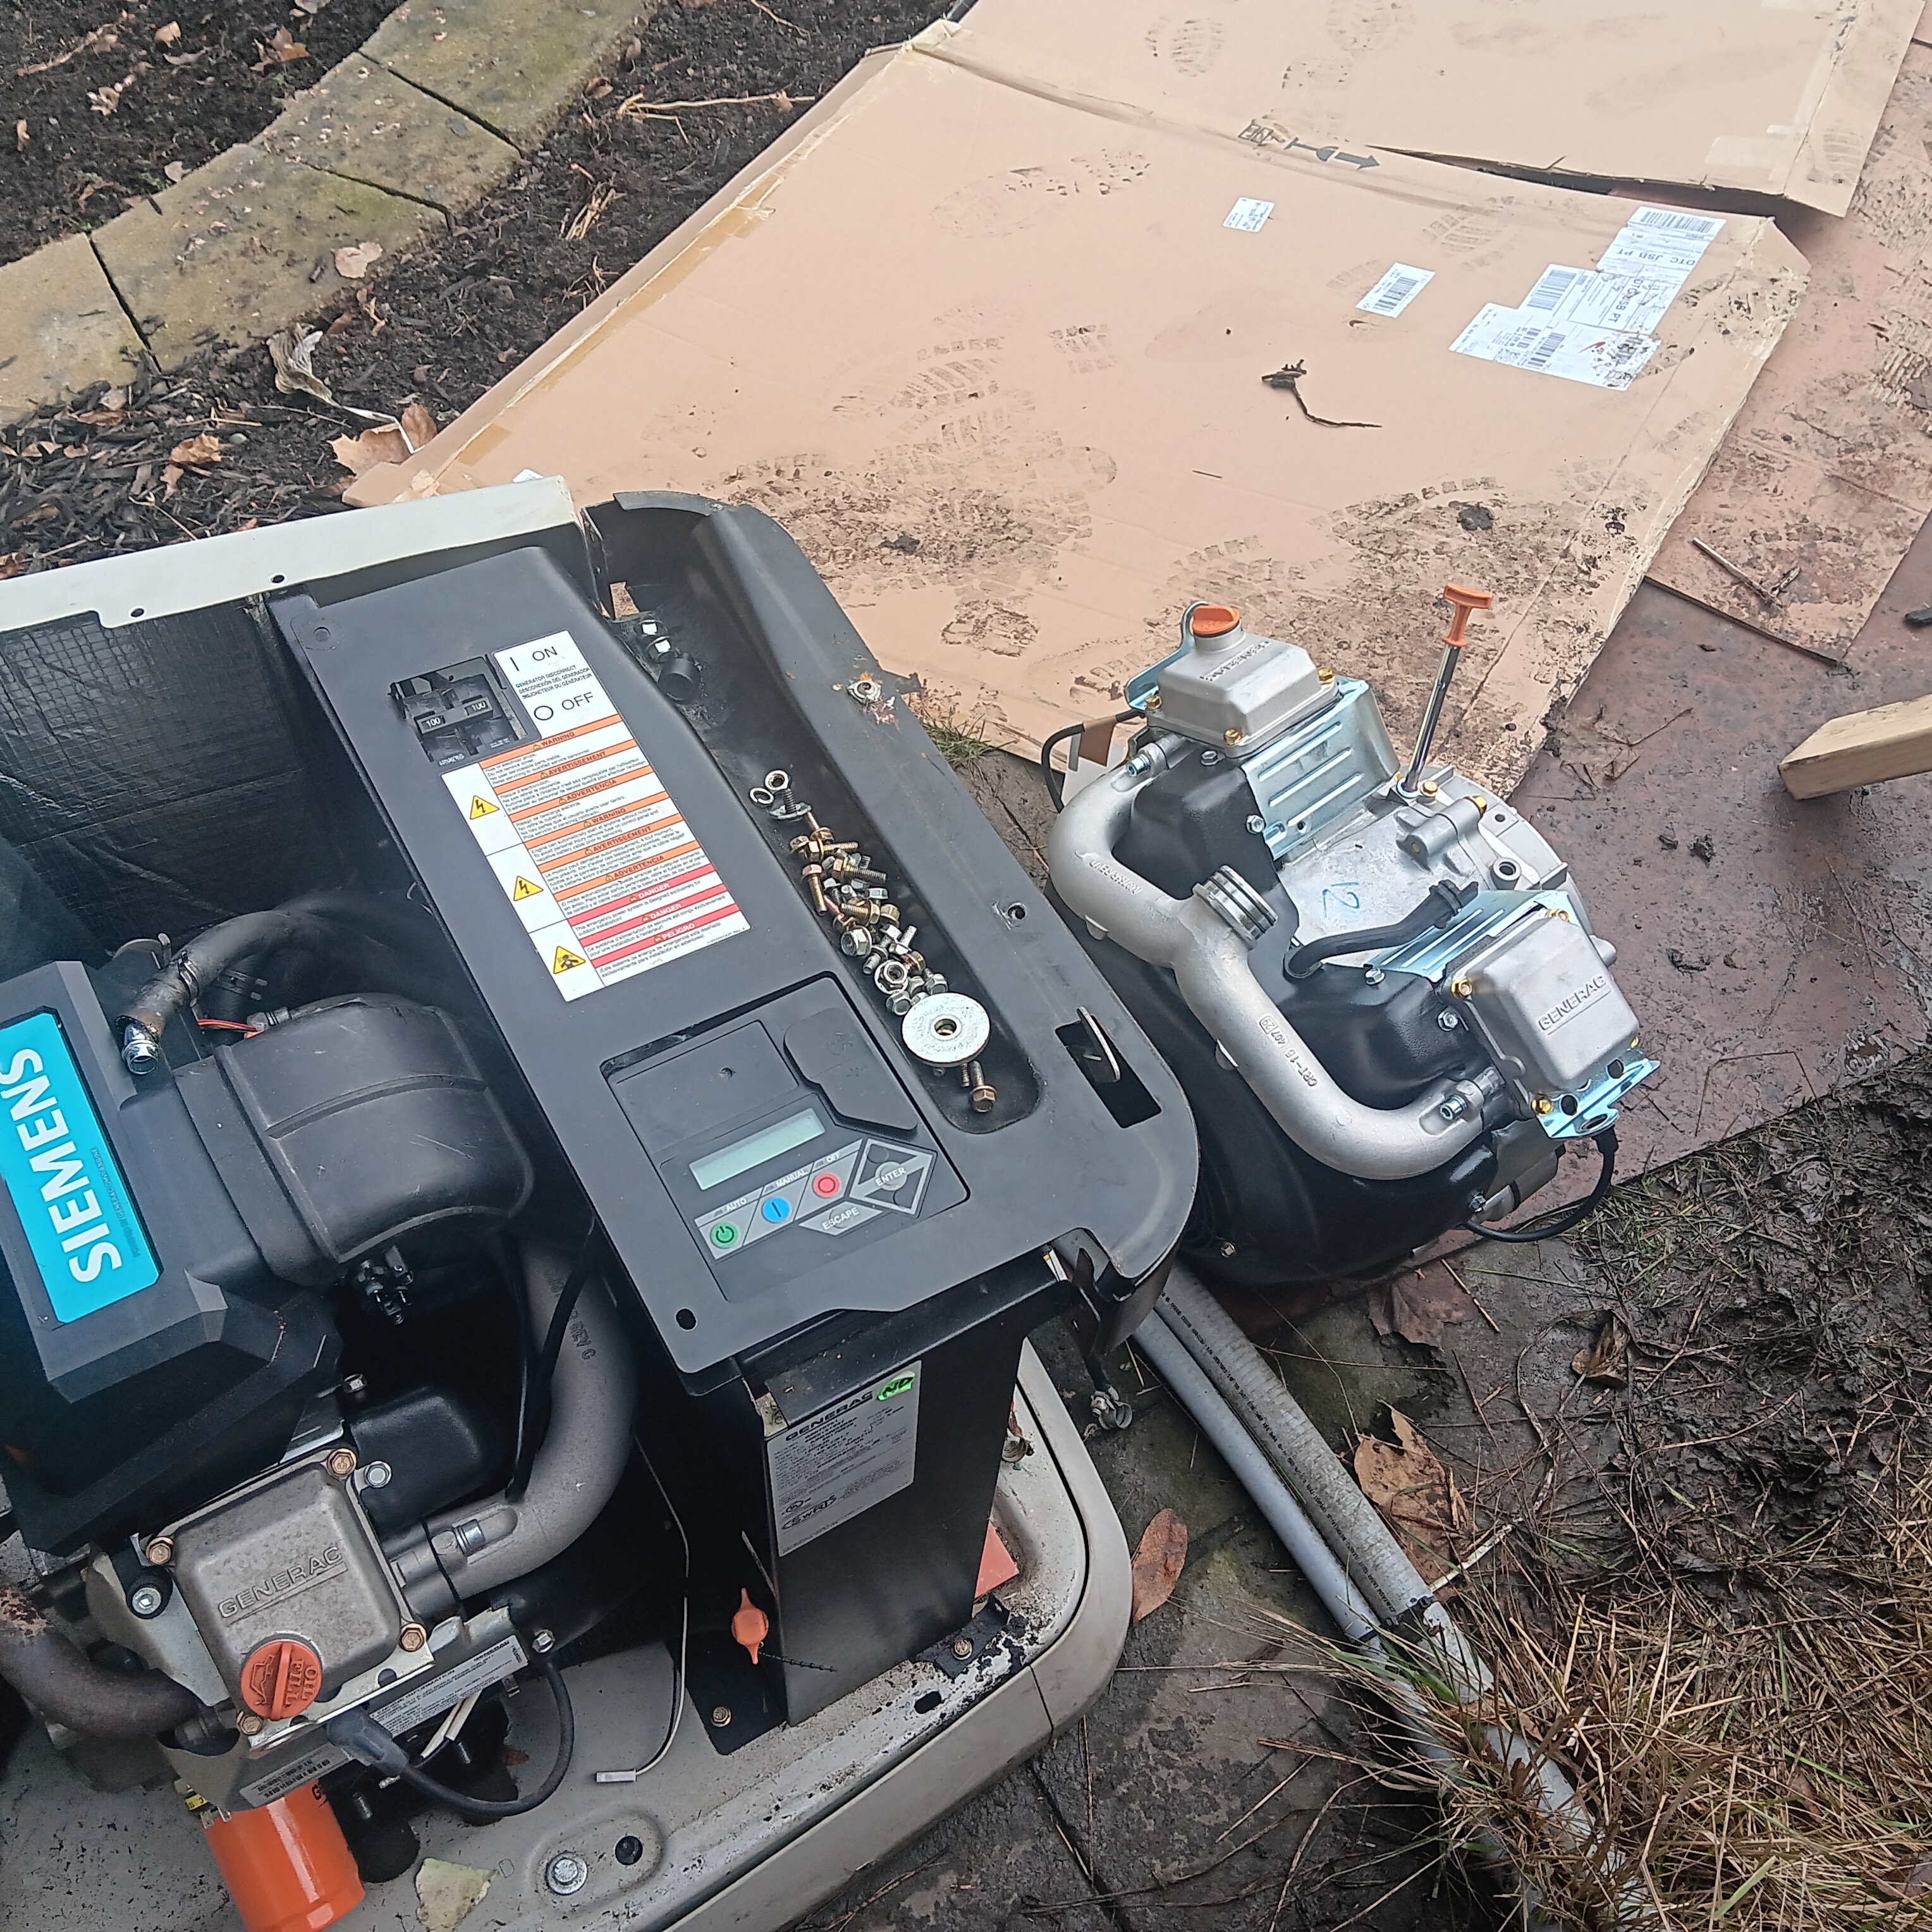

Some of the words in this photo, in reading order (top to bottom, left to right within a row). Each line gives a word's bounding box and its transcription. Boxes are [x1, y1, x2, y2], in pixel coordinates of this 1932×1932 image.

[1639, 252, 1663, 260] JSB
[1669, 257, 1696, 266] DTC
[1608, 312, 1621, 322] PT
[532, 646, 558, 661] ON
[515, 675, 545, 688] GENERATOR
[546, 664, 577, 678] DISCONNECT
[561, 667, 590, 680] GENERADOR
[472, 701, 486, 711] 100
[561, 692, 594, 711] OFF
[425, 717, 441, 728] 100
[541, 731, 575, 747] WARNING
[547, 750, 608, 775] AVERTISSEMENT
[565, 778, 618, 801] ADVERTENCIA
[591, 807, 627, 824] WARNING
[592, 826, 652, 852] AVERTISSEMENT
[612, 855, 665, 878] ADVERTENCIA
[637, 882, 671, 899] DANGER
[585, 914, 612, 928] emergency
[611, 908, 627, 919] power
[626, 902, 644, 912] system
[647, 891, 671, 904] designed
[669, 883, 695, 896] exclusively
[649, 902, 683, 919] DANGER
[661, 922, 696, 940] PELIGRO
[1537, 974, 1607, 1032] GENERAC
[0, 1048, 123, 1283] SIEMENS
[90, 1147, 106, 1171] ENGINE
[826, 1151, 841, 1163] OFF
[776, 1168, 809, 1189] MANUAL
[875, 1166, 907, 1187] ENTER
[106, 1187, 125, 1218] GENERAC
[726, 1197, 747, 1213] AUTO
[821, 1207, 860, 1232] ESCAPE
[785, 1390, 873, 1442] GENERAC
[218, 1544, 344, 1620] GENERAC
[285, 1658, 305, 1706] FILL
[302, 1665, 319, 1701] OIL
